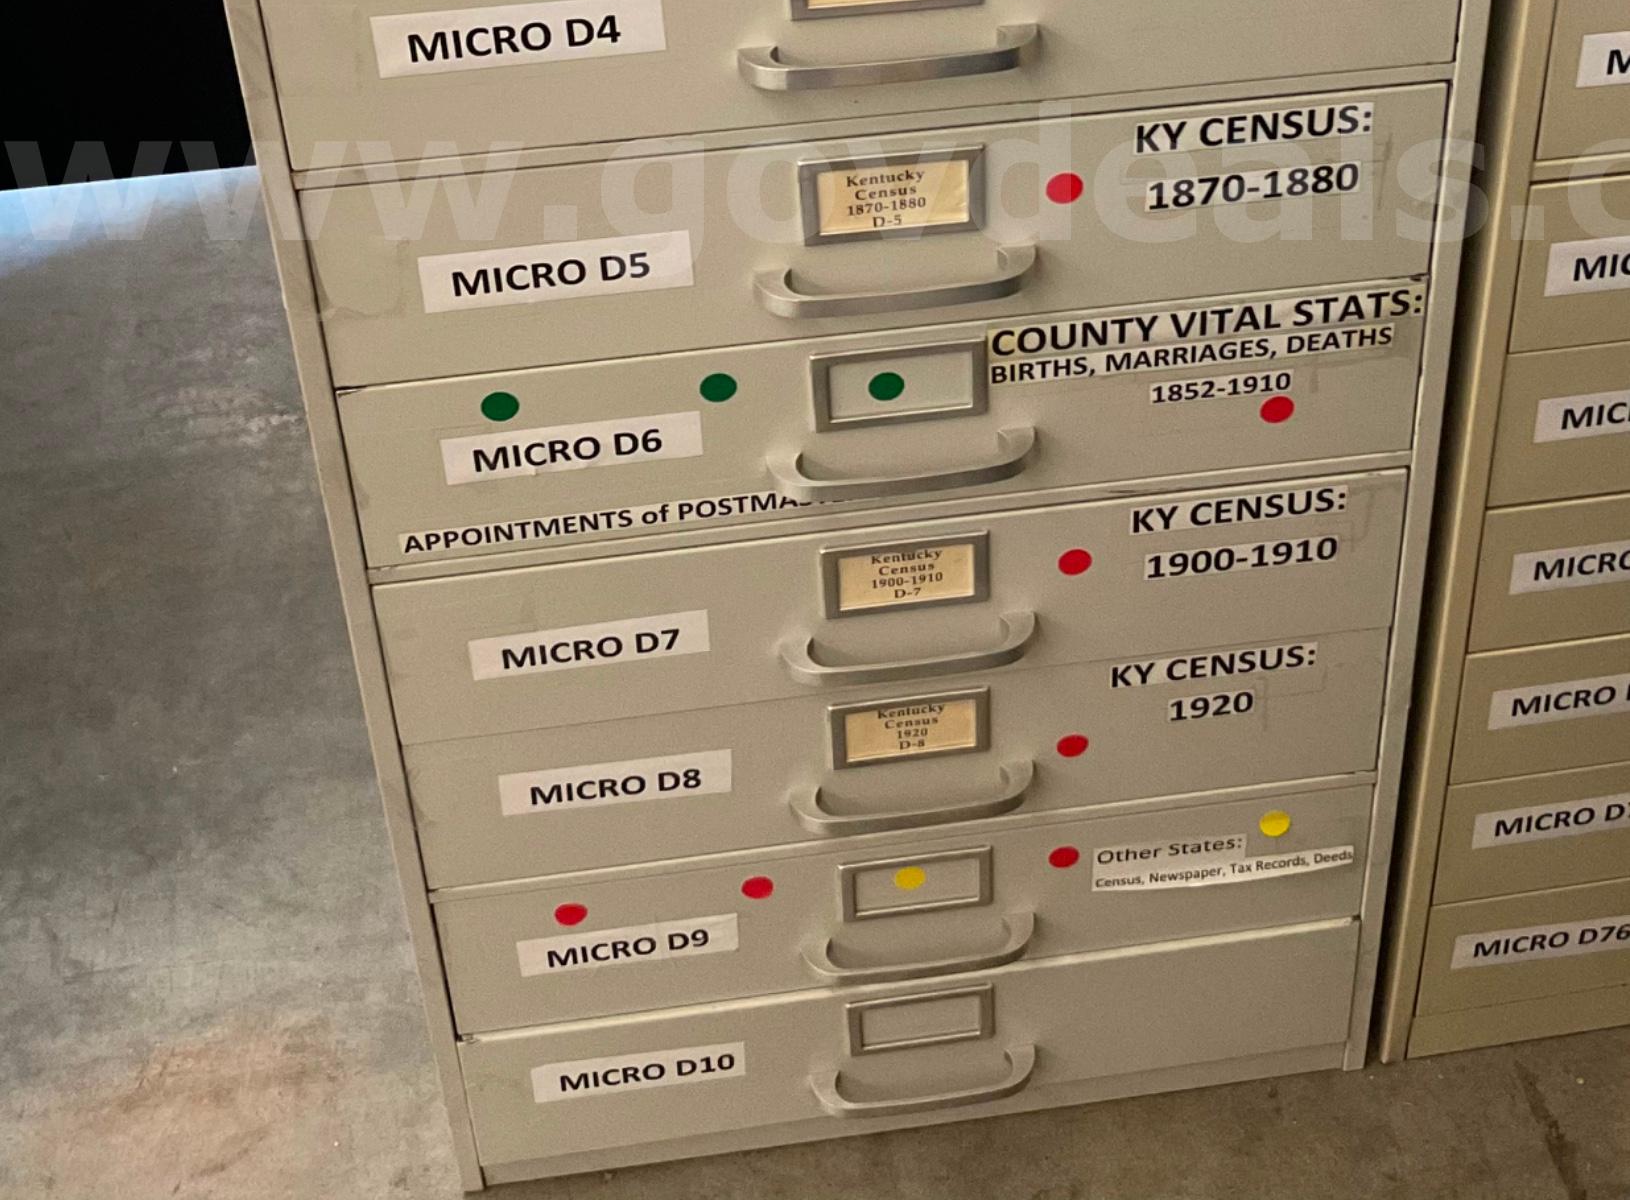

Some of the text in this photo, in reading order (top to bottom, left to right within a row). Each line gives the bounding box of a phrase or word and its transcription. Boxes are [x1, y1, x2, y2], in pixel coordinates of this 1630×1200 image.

[407, 15, 621, 63] MICRO D4
[1136, 105, 1372, 153] KY CENSUS:
[846, 170, 925, 187] Kentucky
[855, 186, 917, 200] Census
[1149, 163, 1358, 210] 1870-1880
[848, 197, 926, 216] 1870-1880
[873, 215, 902, 228] D-5
[452, 252, 650, 297] MICRO D5
[992, 290, 1423, 357] COUNTY VITAL STATS:
[990, 327, 1393, 384] BIRTHS, MARRIAGES, DEATHS
[1152, 372, 1292, 404] 1852-1910
[473, 428, 663, 473] MICRO D6
[404, 493, 847, 553] APPOINTMENTS of POSTMA
[1132, 488, 1346, 533] KY CENSUS:
[871, 550, 942, 565] Kentucky
[879, 563, 935, 576] Census
[1147, 537, 1338, 579] 1900-1910
[872, 572, 943, 589] 1900-1910
[894, 588, 921, 599] D-7
[502, 629, 680, 669] MICRO D7
[1111, 645, 1315, 688] KY CENSUS:
[877, 704, 945, 719] Kentucky
[1170, 691, 1254, 721] 1920
[1511, 686, 1616, 717] MICRO
[884, 717, 938, 729] Census
[897, 728, 928, 739] 1920
[530, 768, 701, 805] MICRO D8
[1494, 802, 1630, 837] MICRO D
[1095, 849, 1353, 888] Census, Newspaper, Tax Records, Deeds
[1097, 837, 1242, 865] Other States:
[547, 929, 709, 968] MICRO D9
[1474, 924, 1630, 958] MICRO D76
[560, 1054, 735, 1092] MICRO D10
